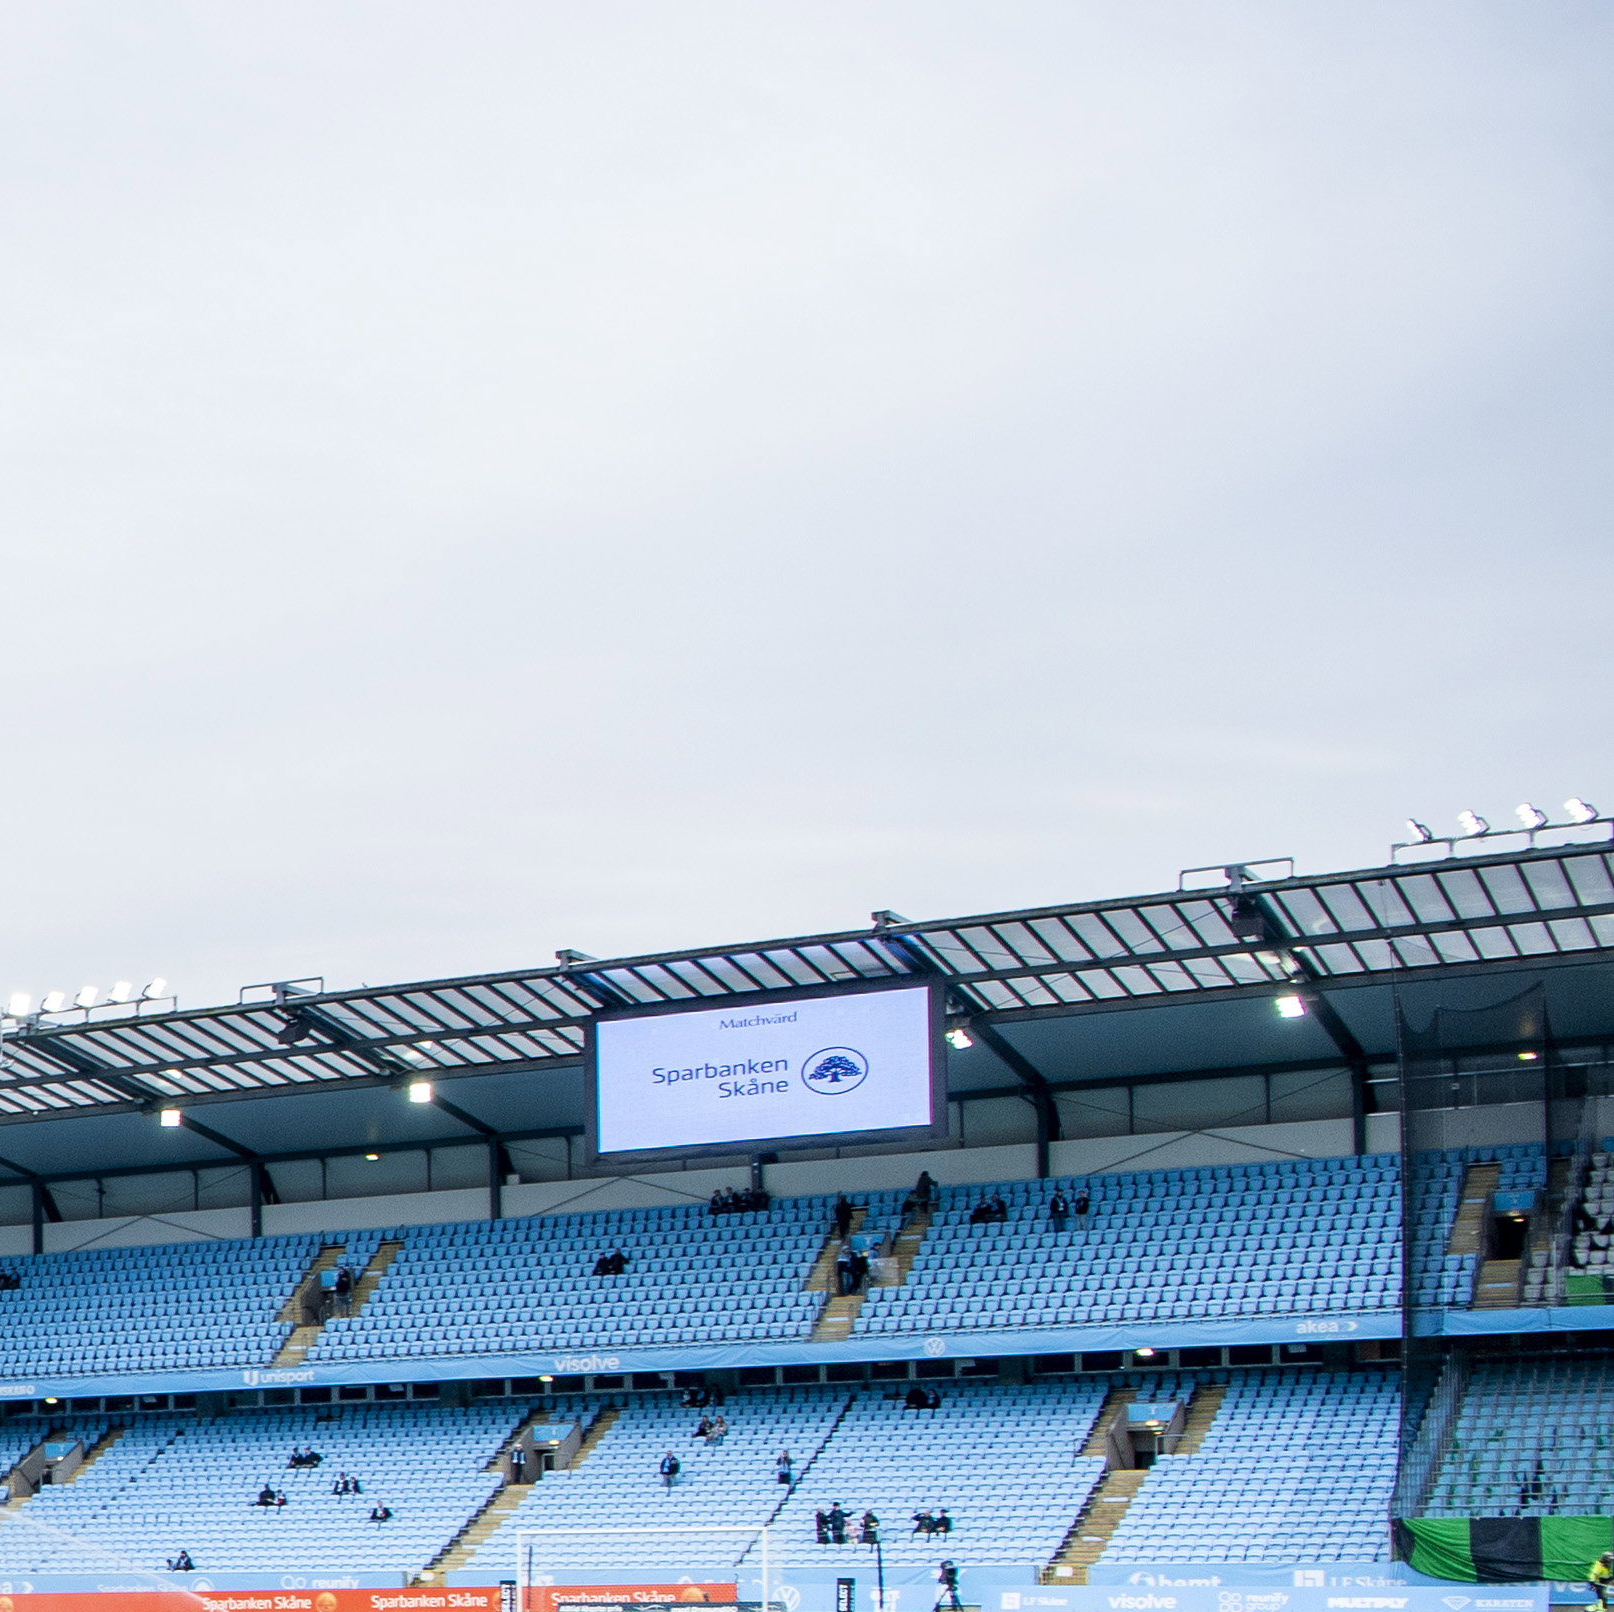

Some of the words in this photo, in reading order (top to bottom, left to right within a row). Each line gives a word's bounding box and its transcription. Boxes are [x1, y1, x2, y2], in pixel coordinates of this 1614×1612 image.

[652, 1057, 788, 1085] Sparbanken
[719, 1078, 788, 1098] Skåne
[1296, 1320, 1338, 1333] akea
[555, 1355, 619, 1371] visolve
[261, 1370, 315, 1384] unisport
[202, 1596, 271, 1611] Sparbanken
[274, 1594, 311, 1609] Skåne
[371, 1594, 445, 1610] Sparbanken
[447, 1592, 488, 1607] Skåne
[1108, 1593, 1176, 1609] visolve
